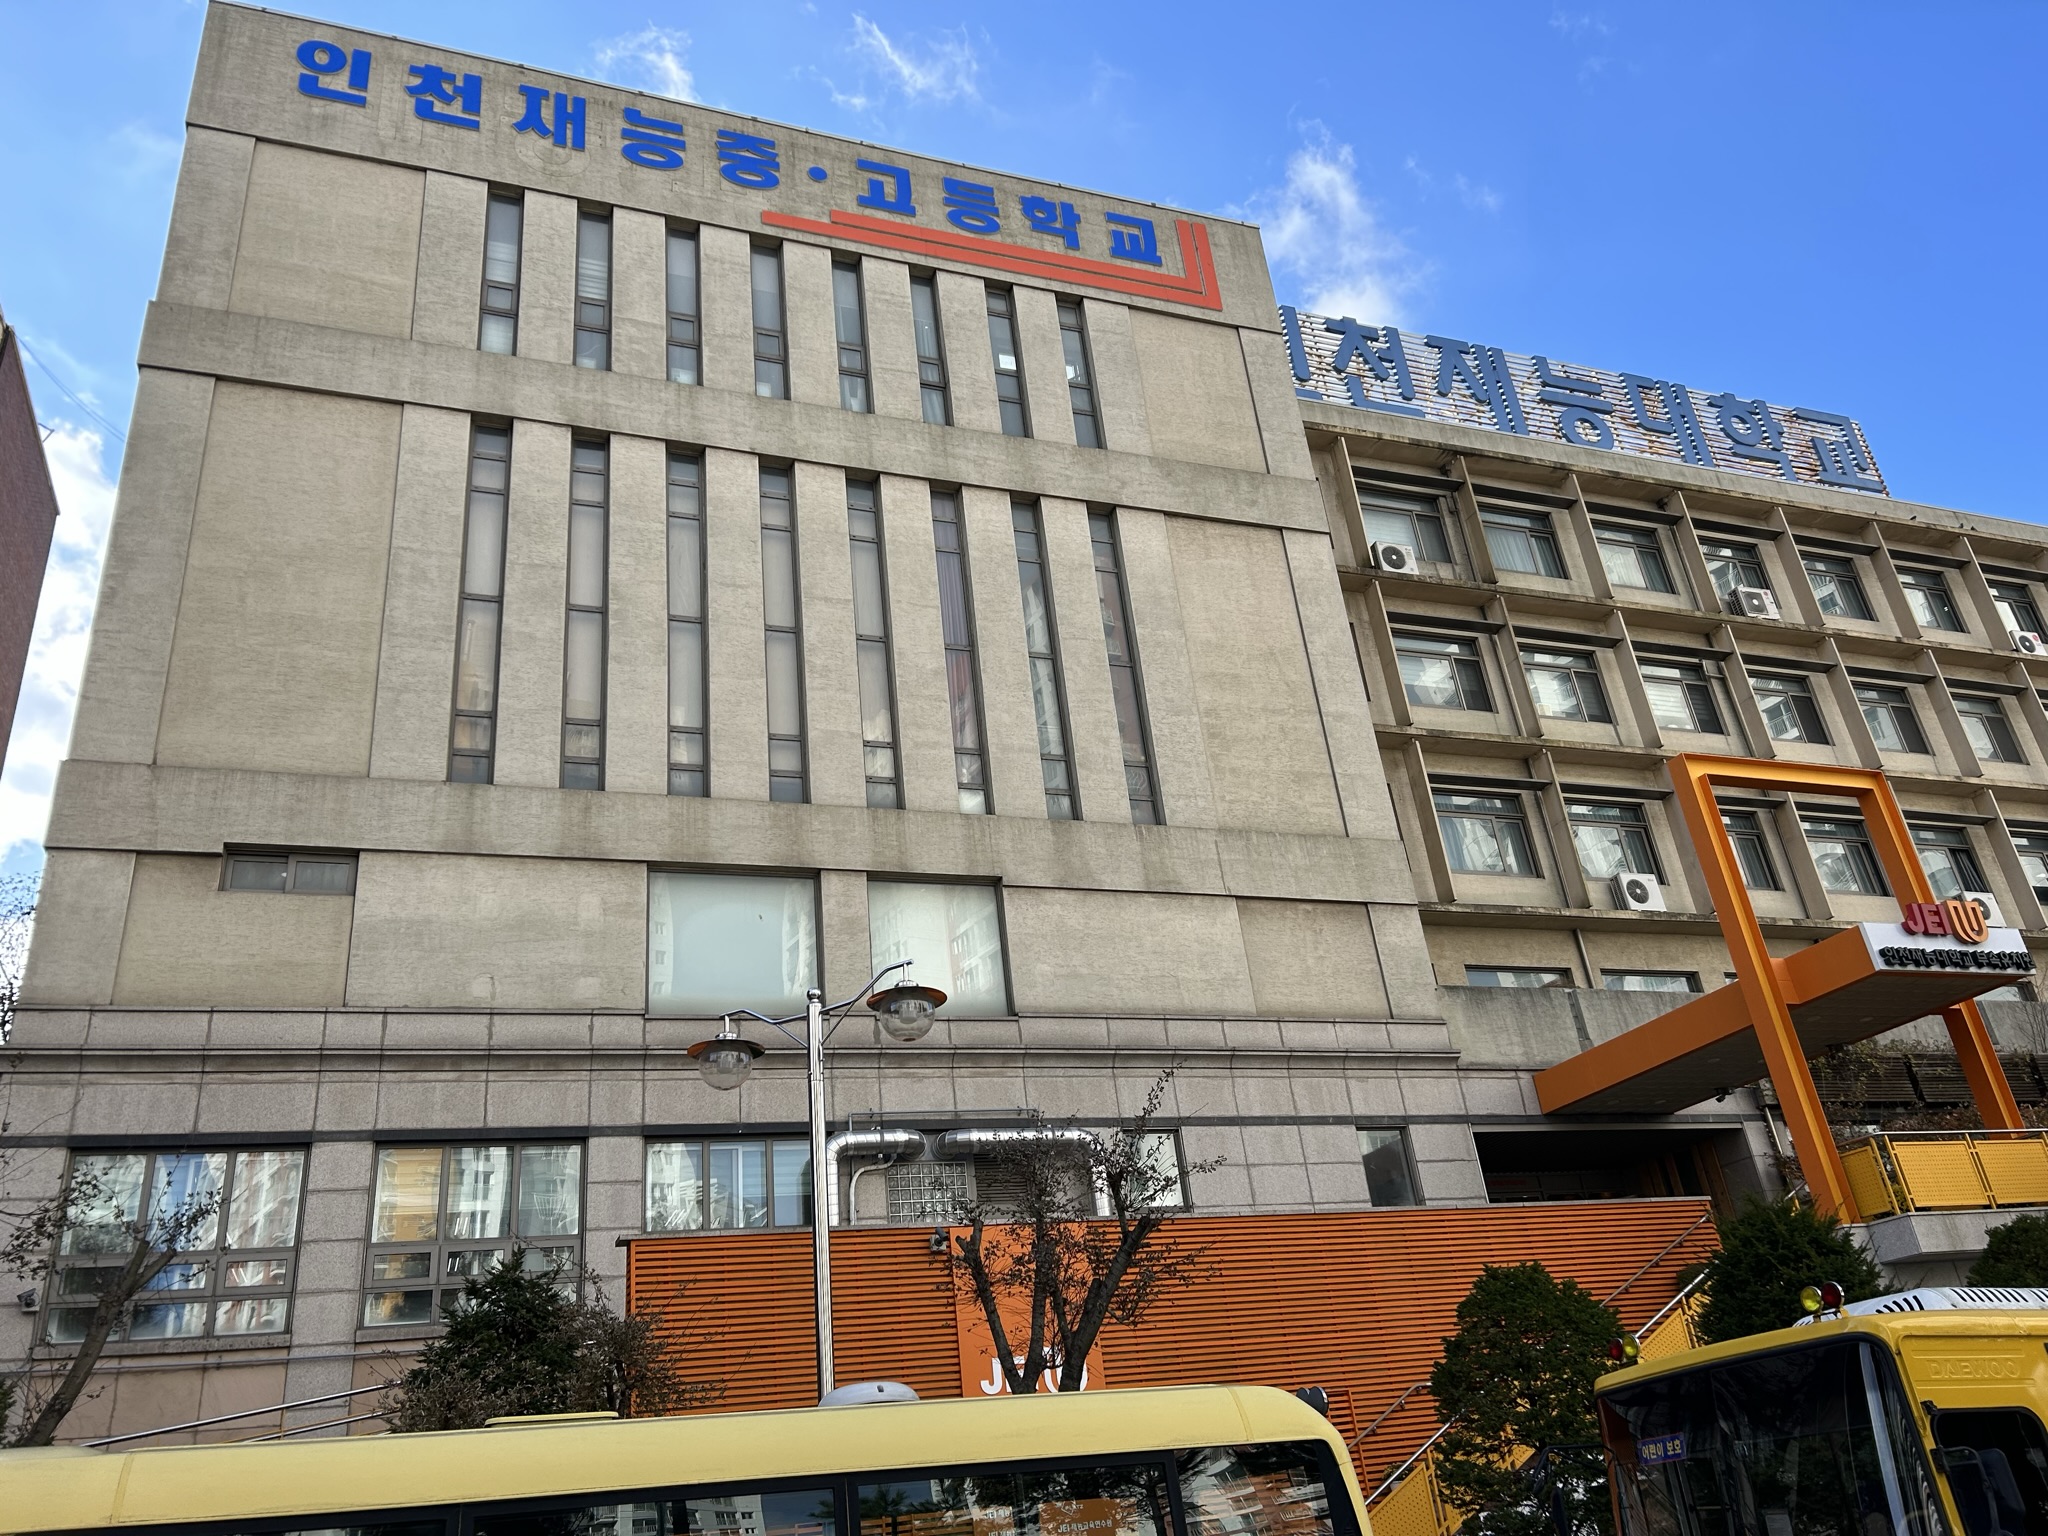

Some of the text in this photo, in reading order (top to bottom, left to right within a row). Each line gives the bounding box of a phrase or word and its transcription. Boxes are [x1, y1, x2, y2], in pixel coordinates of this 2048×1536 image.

[1880, 946, 2036, 971] 인천재능대학교 부속유치원
[1926, 1360, 2020, 1379] DAEWOO
[1642, 1438, 1681, 1460] 어린이 보호
